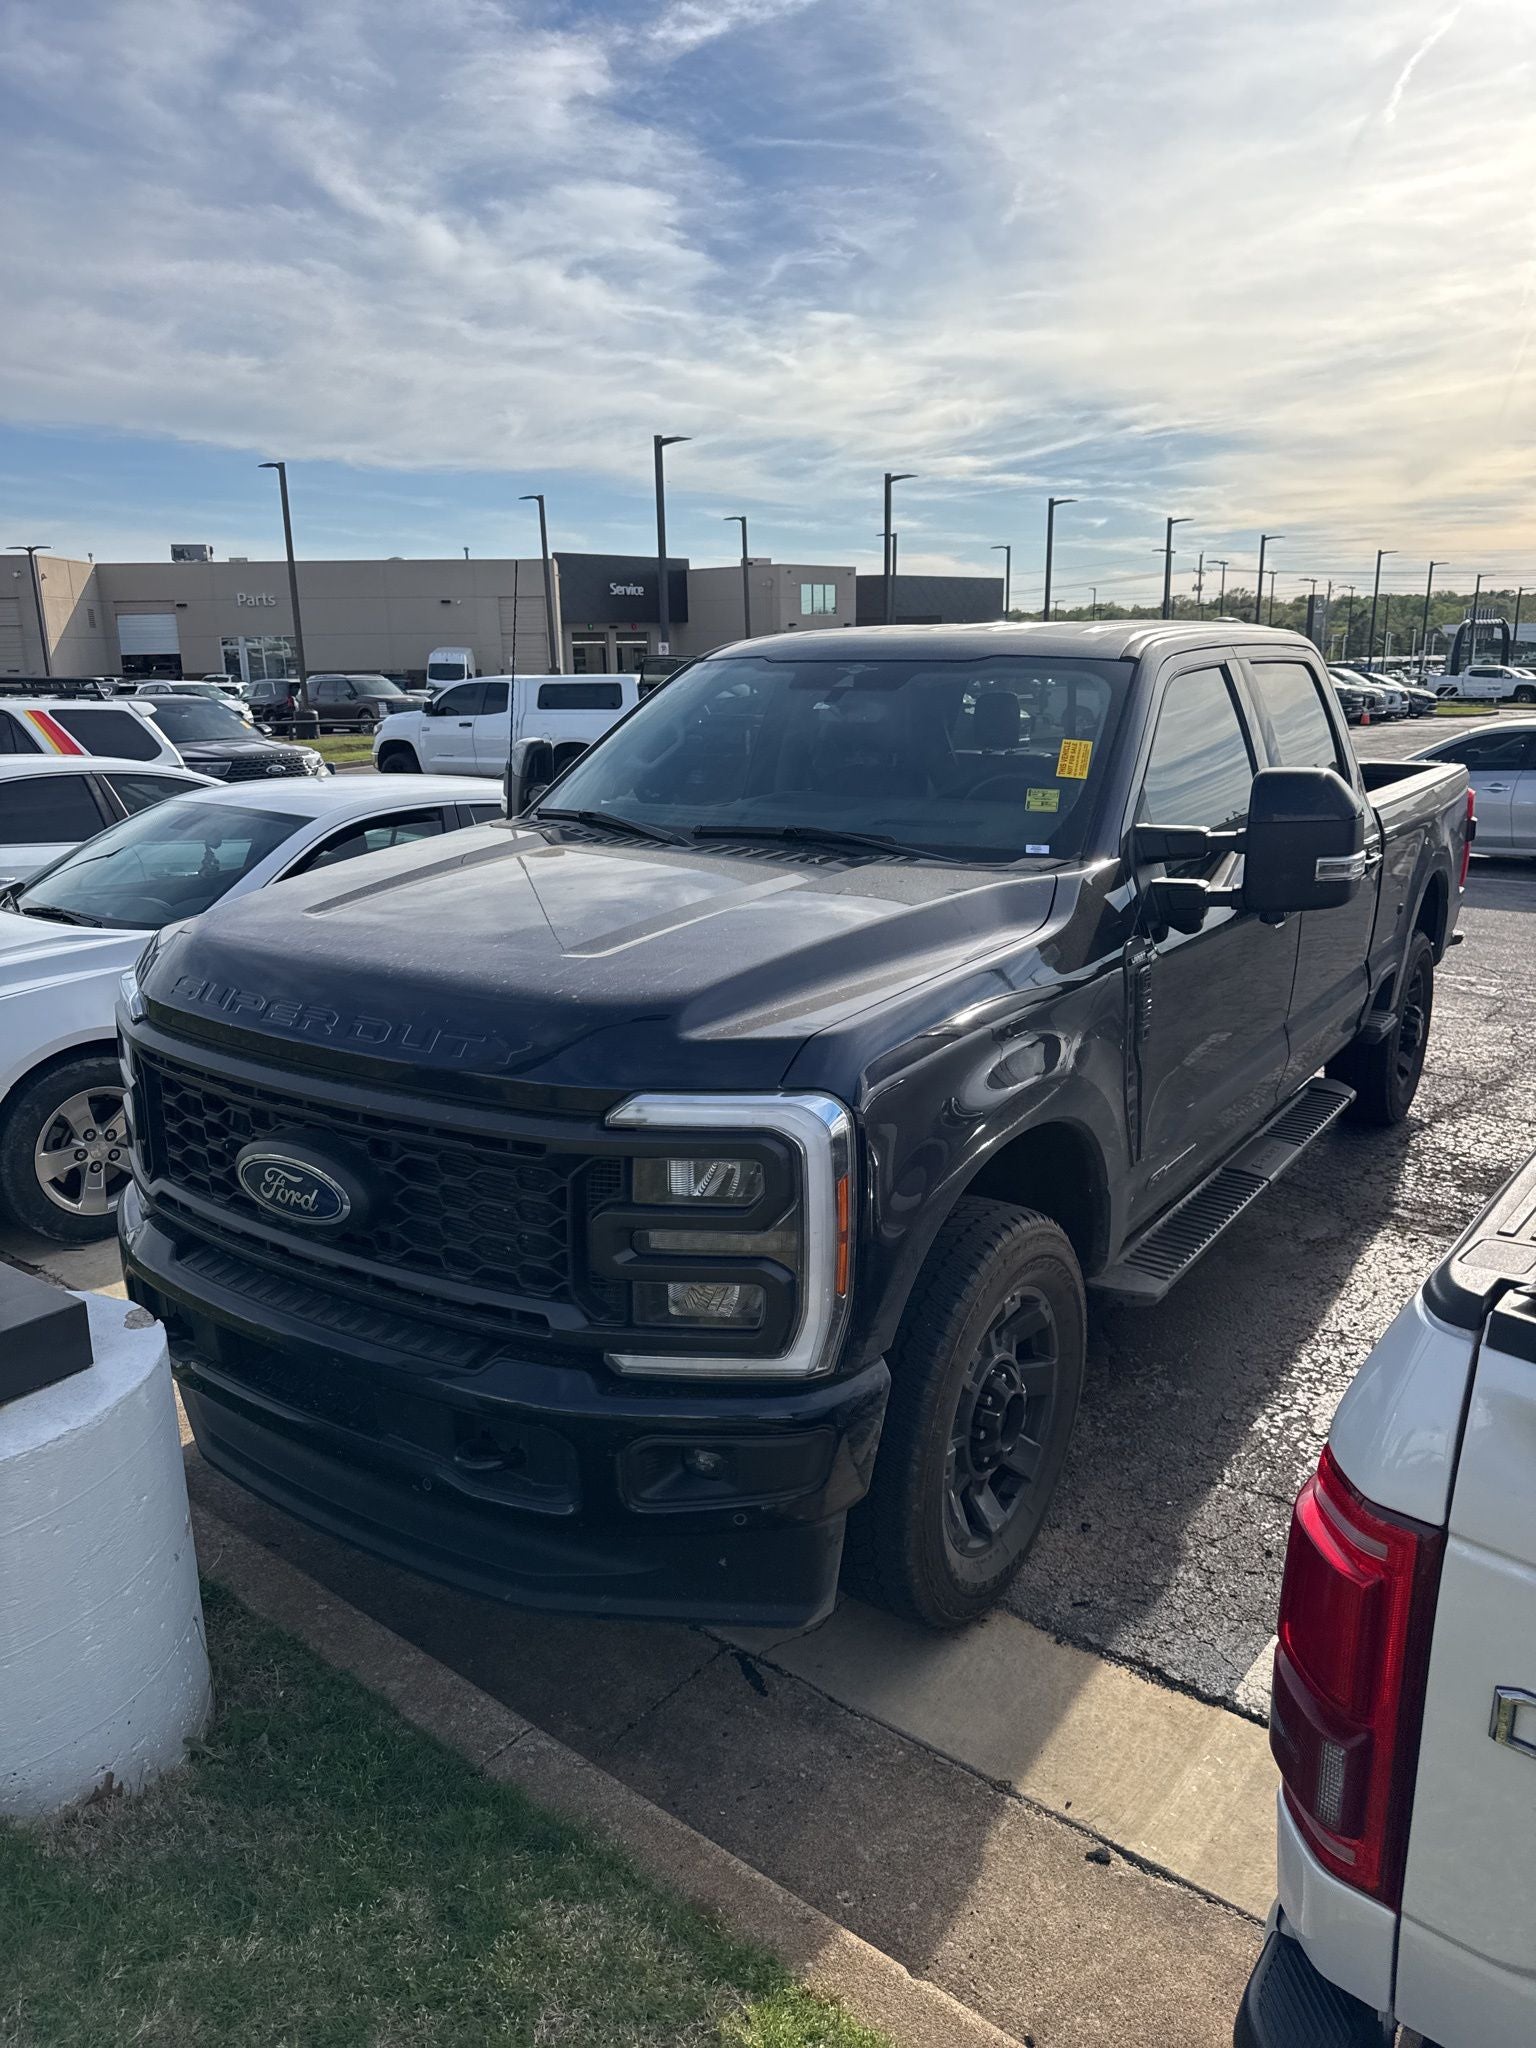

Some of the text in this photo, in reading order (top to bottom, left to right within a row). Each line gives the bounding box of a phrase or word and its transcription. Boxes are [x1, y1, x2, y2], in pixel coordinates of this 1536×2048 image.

[237, 592, 276, 606] Parts
[610, 582, 644, 596] Service
[170, 974, 533, 1065] SUPER DUTY
[261, 1167, 318, 1212] Ford
